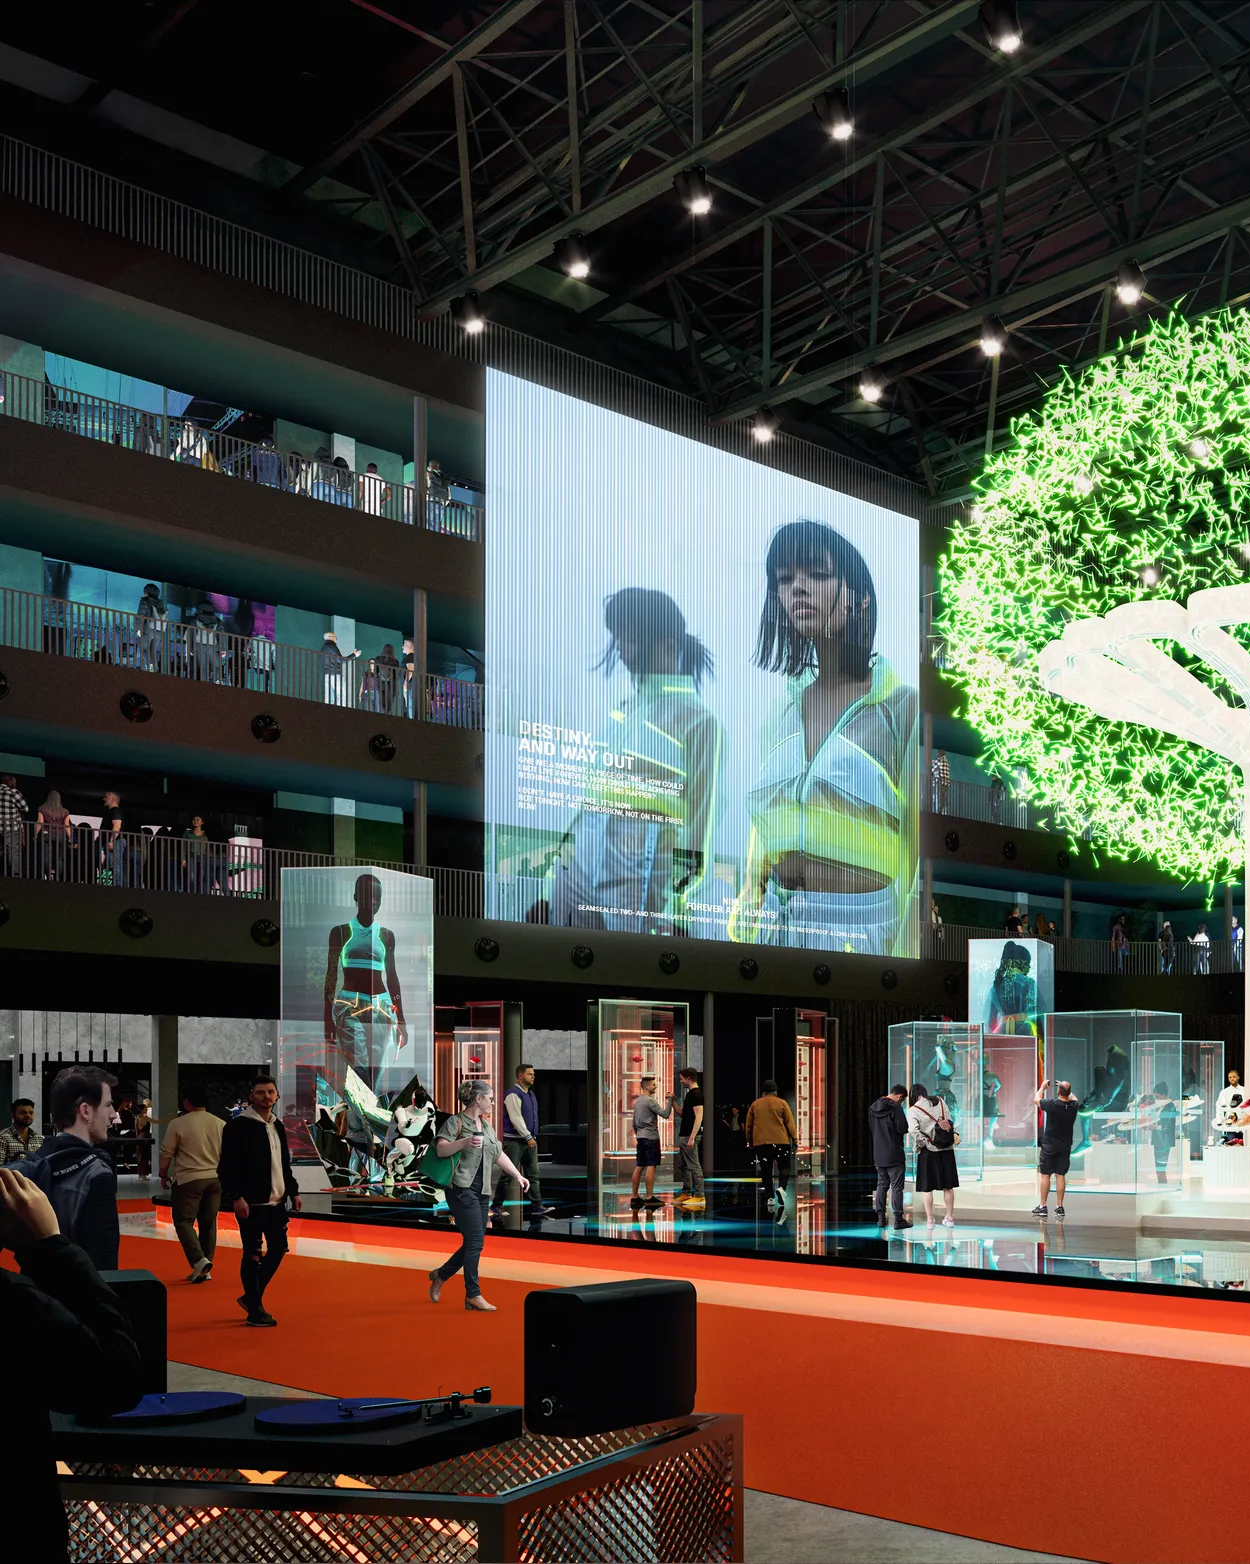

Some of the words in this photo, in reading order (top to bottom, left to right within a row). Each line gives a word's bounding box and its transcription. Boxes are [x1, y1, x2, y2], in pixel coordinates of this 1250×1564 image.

[519, 720, 594, 749] DESTINY,
[518, 738, 555, 756] AND
[561, 743, 598, 763] WAY
[603, 752, 635, 770] OUT
[595, 768, 614, 778] PIECE
[616, 771, 624, 780] OF
[645, 776, 661, 786] HOW
[662, 779, 683, 789] COULD
[625, 811, 638, 819] NOT
[640, 813, 650, 821] ON
[651, 815, 663, 823] THE
[686, 902, 722, 913] FOREVER
[744, 909, 776, 919] ALWAYS
